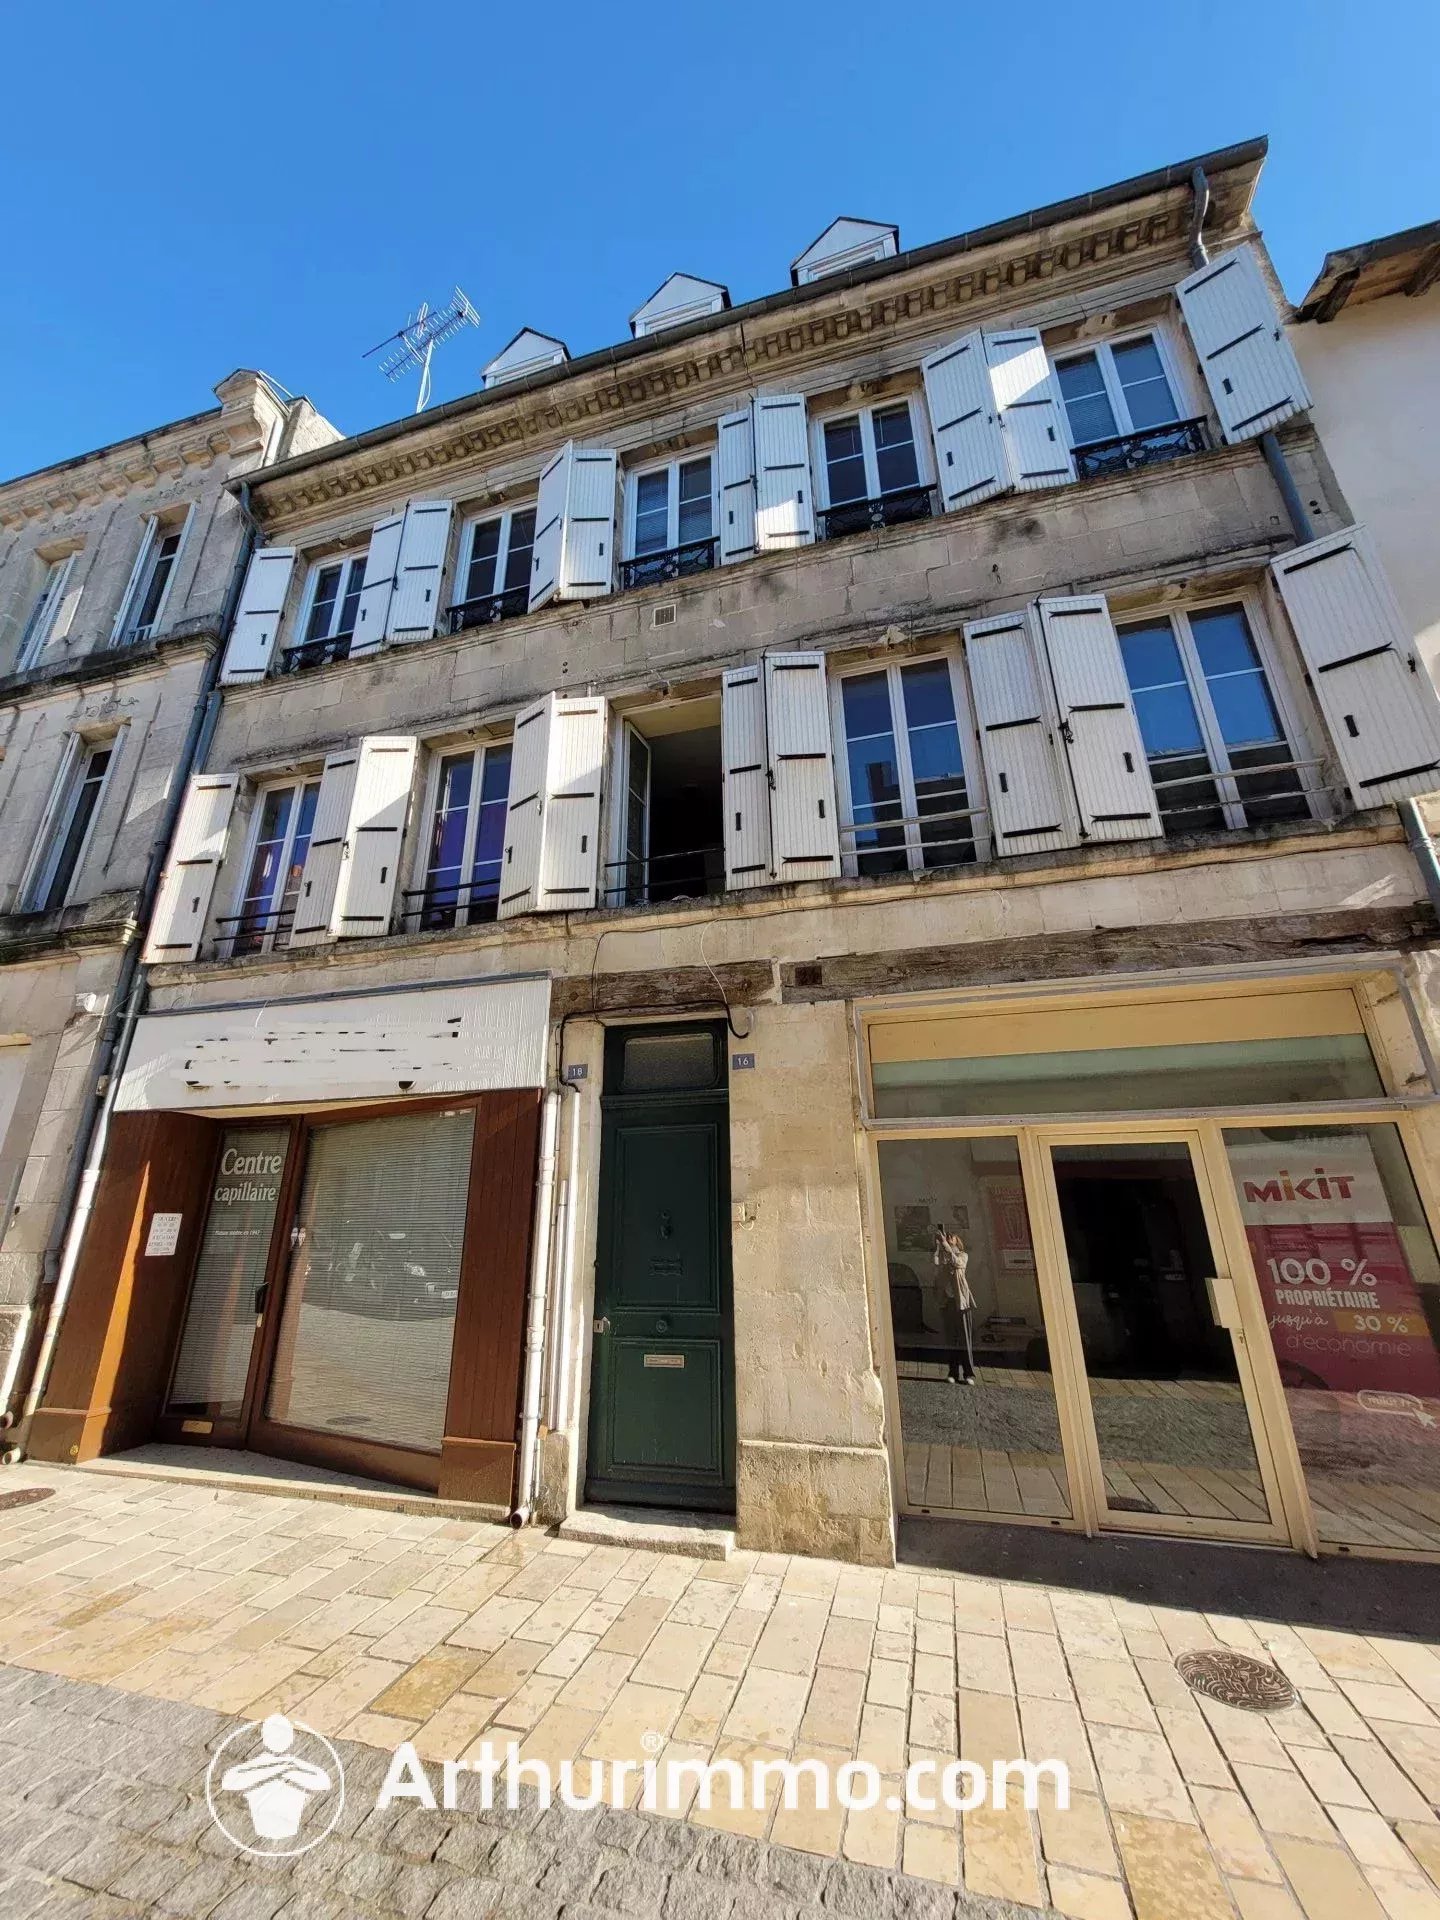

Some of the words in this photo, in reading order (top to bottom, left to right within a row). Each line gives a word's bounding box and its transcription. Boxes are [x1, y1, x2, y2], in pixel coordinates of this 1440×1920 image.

[572, 1067, 583, 1076] 18
[737, 1057, 749, 1066] 16
[221, 1148, 282, 1175] Centre
[215, 1181, 276, 1206] capillaire
[1266, 1257, 1331, 1285] 100
[1340, 1258, 1378, 1286] %
[1275, 1287, 1380, 1309] PROPRIÉTAIRE
[1353, 1314, 1381, 1331] 30
[1387, 1315, 1409, 1333] %
